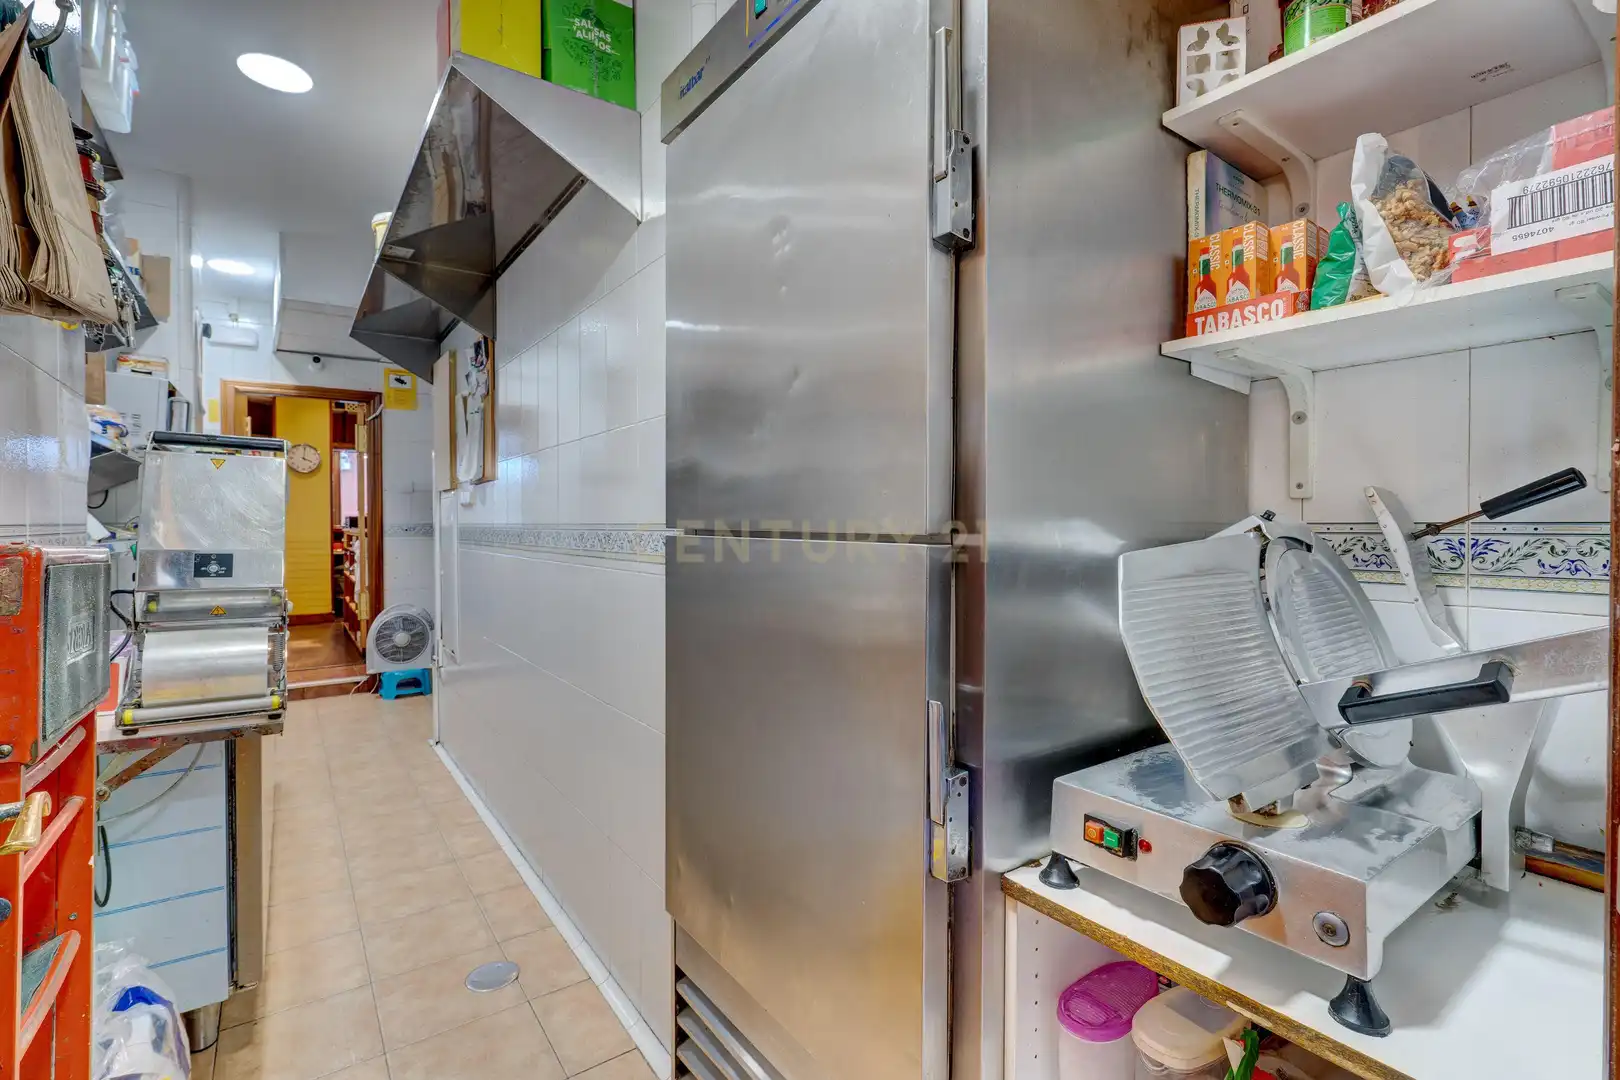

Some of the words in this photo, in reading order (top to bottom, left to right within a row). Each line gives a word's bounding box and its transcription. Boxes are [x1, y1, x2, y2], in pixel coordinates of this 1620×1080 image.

[574, 17, 612, 42] SALSAS
[1209, 233, 1221, 271] CLASSIC
[1243, 223, 1255, 262] CLASSIC
[1292, 220, 1305, 260] CLASSIC
[1512, 226, 1555, 242] 4074655
[1194, 298, 1284, 337] TABASCO
